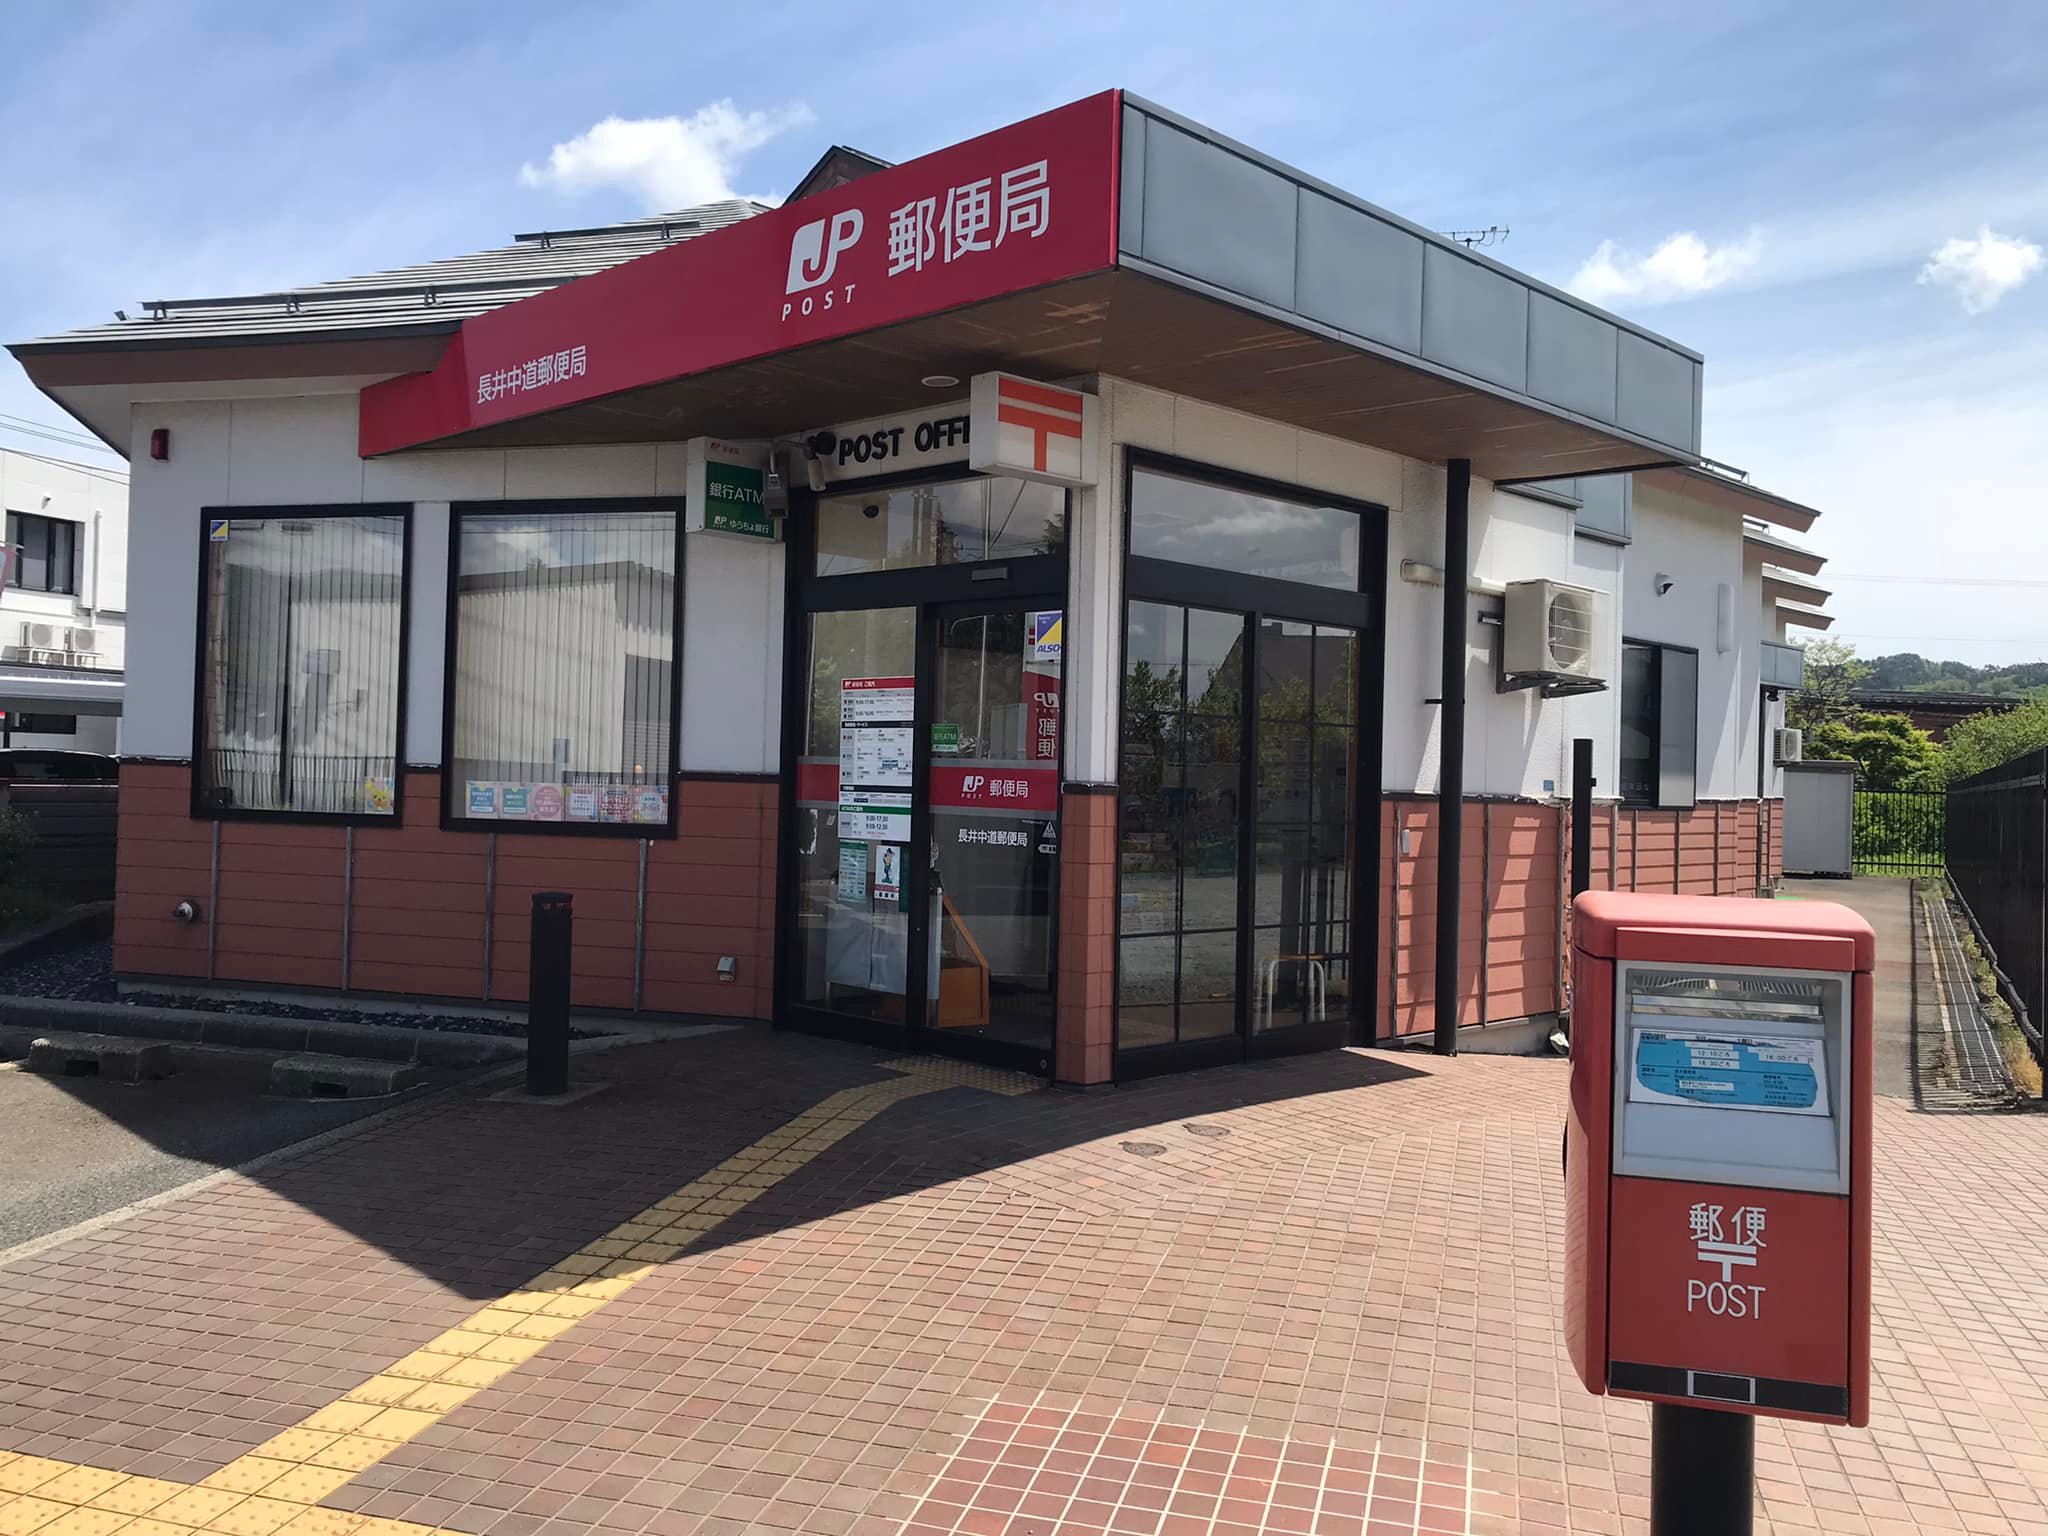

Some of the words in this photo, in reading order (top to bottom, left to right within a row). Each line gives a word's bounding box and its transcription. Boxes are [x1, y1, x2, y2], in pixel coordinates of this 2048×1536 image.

[887, 159, 1050, 278] 郵便局
[781, 284, 856, 322] POST
[476, 345, 587, 405] 長井中道郵便局
[839, 427, 904, 466] POST
[709, 481, 765, 505] 銀行ATM
[1037, 643, 1061, 654] ALSO
[989, 779, 1029, 799] 郵便局
[958, 828, 1028, 848] 長井中道郵便局
[1688, 1202, 1768, 1248] 郵便
[1687, 1279, 1767, 1320] POST
